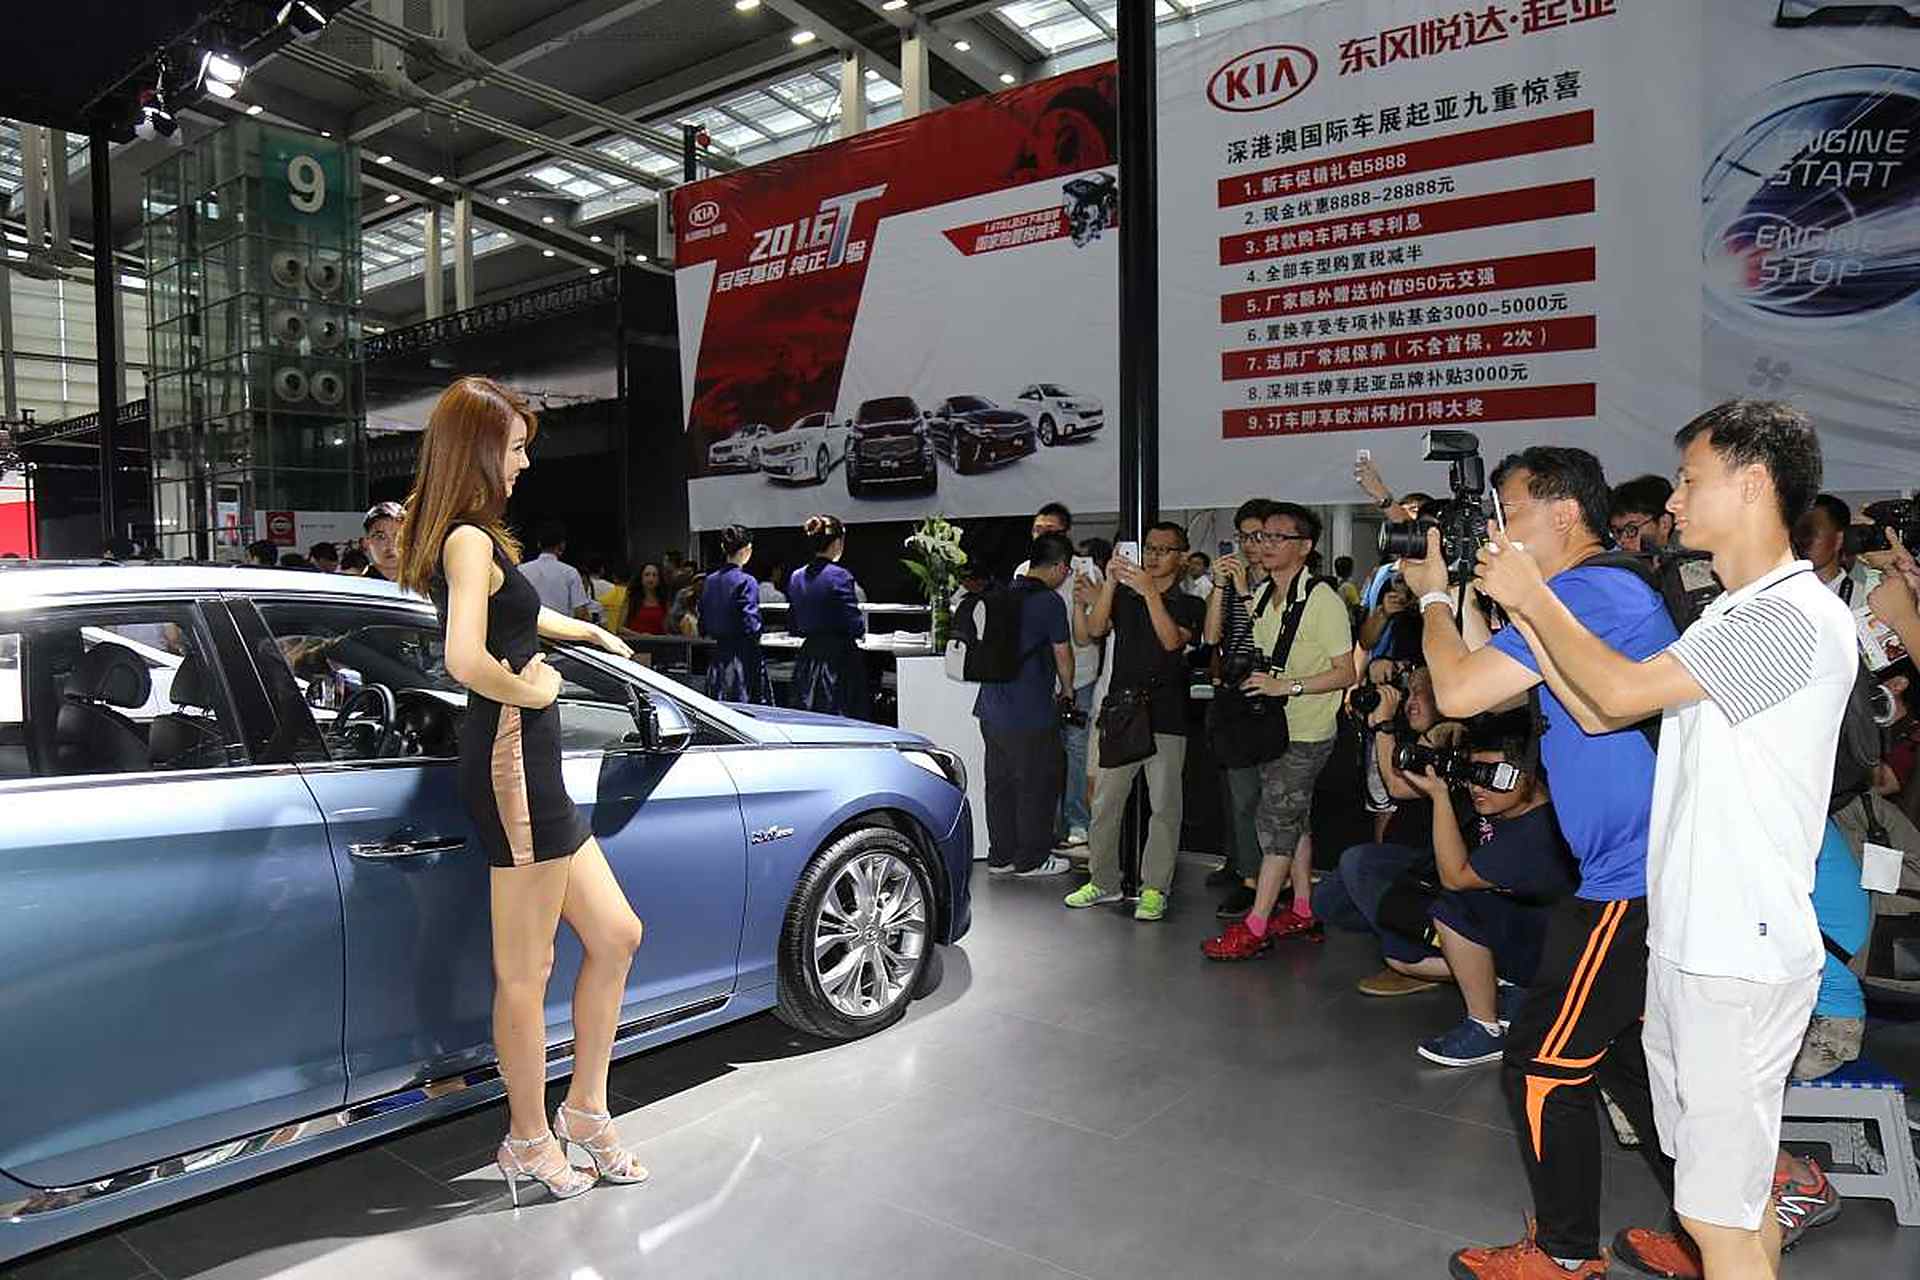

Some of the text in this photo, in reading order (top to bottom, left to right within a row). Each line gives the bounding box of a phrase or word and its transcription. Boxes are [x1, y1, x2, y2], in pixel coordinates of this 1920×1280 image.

[1222, 55, 1301, 105] KIA
[1227, 70, 1582, 164] 深港澳国际车展起亚九重惊喜
[286, 154, 326, 213] 9
[1769, 160, 1902, 188] START
[692, 204, 716, 224] KIA
[1758, 255, 1864, 286] STOP
